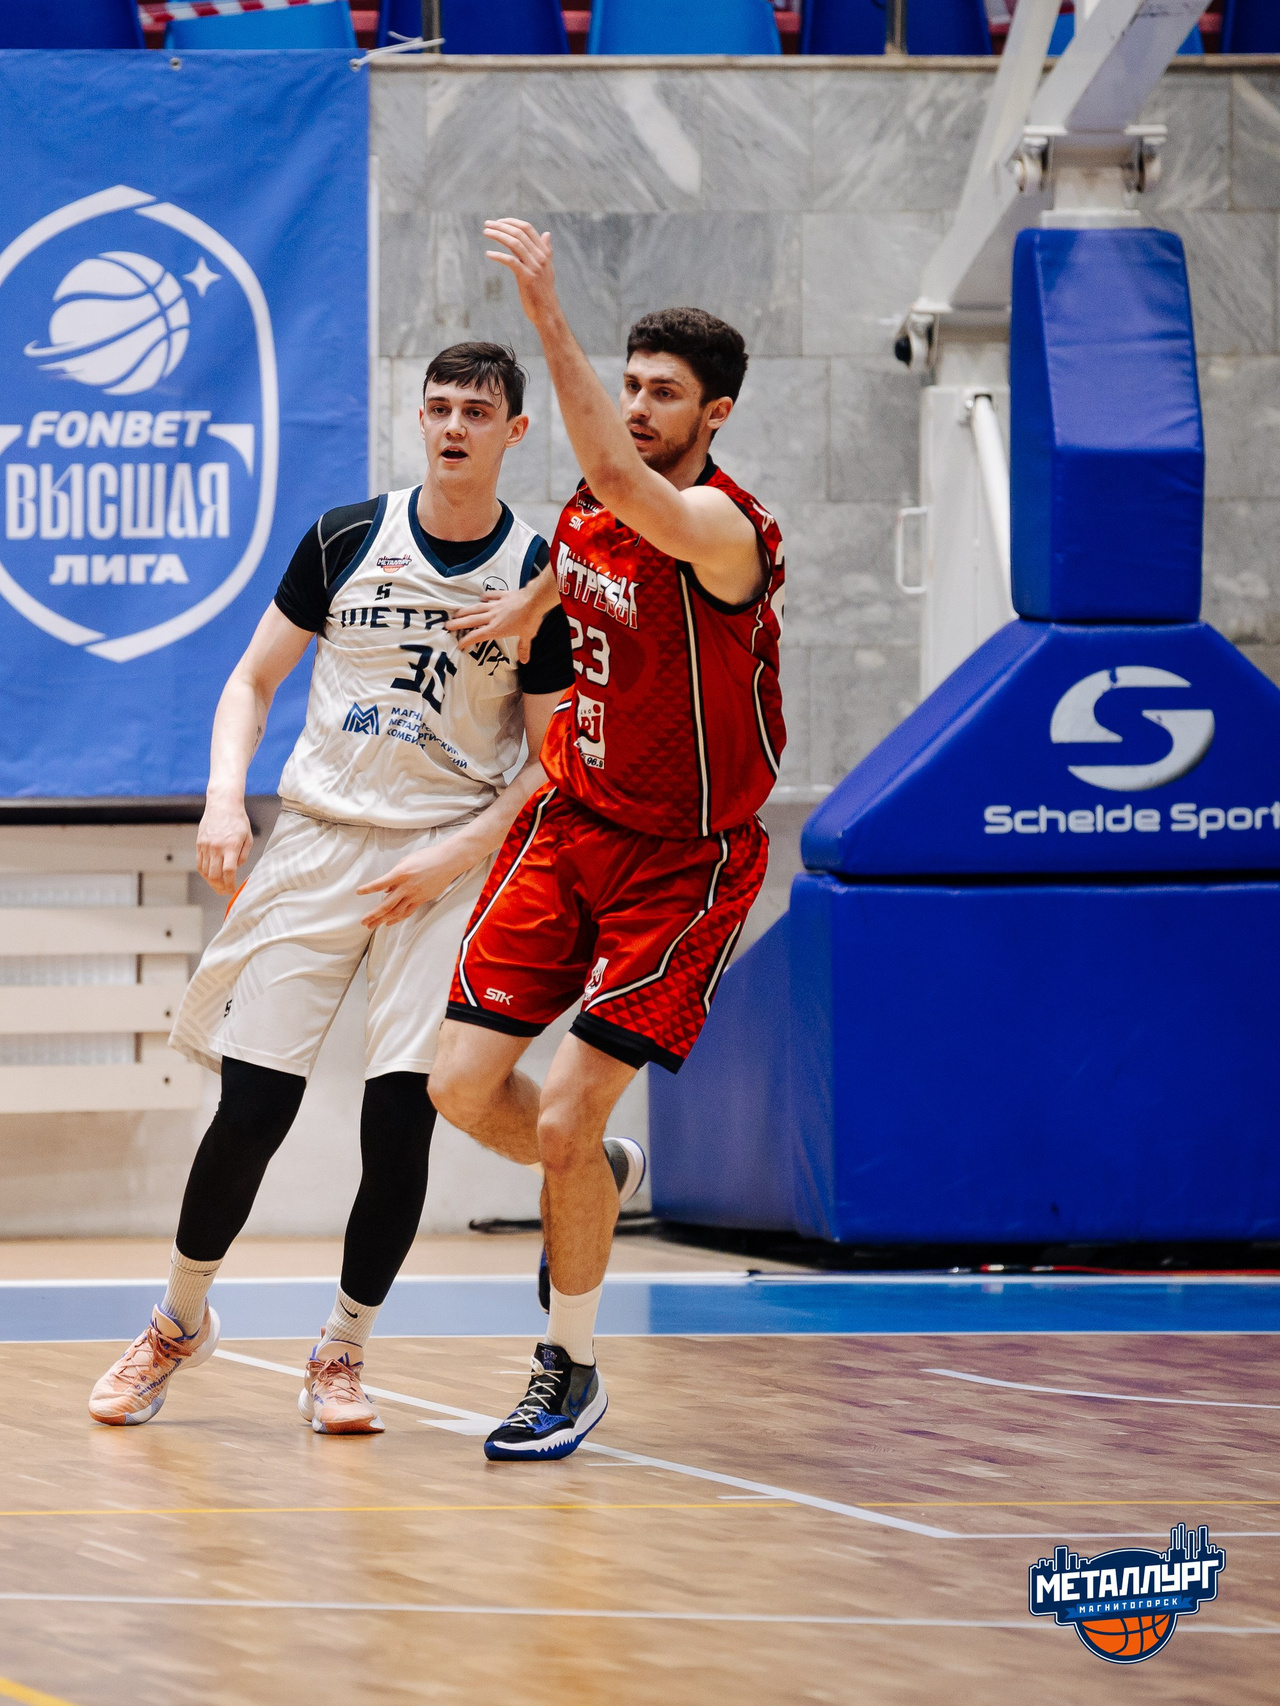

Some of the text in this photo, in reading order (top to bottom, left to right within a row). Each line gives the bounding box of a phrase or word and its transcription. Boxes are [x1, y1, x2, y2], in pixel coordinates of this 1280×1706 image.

[26, 410, 212, 448] FONBET
[6, 462, 230, 540] ВЫСШАЯ
[48, 553, 190, 585] ЛИГА
[566, 614, 611, 688] 23
[983, 804, 1162, 834] Schelde
[483, 987, 514, 1006] STK
